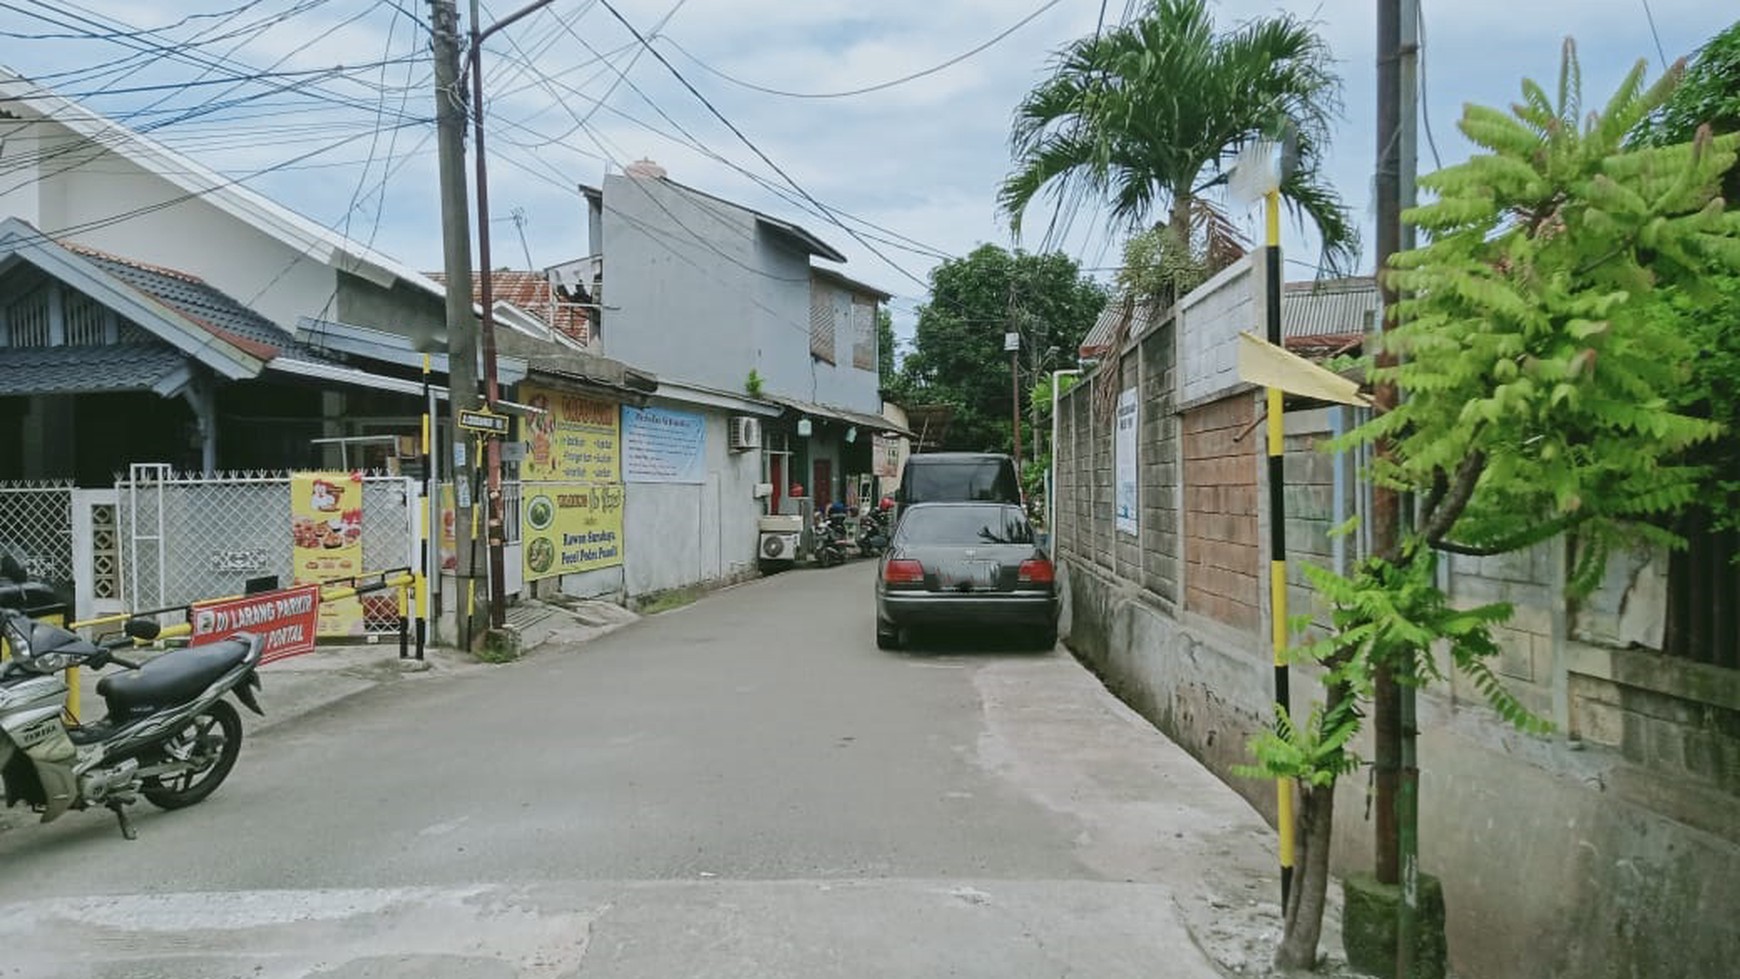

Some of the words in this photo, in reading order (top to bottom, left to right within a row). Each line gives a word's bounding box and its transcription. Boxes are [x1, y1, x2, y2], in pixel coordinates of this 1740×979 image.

[216, 611, 229, 632] DI
[231, 601, 276, 629] LARANG
[276, 594, 312, 620] PARKIR
[267, 624, 305, 649] PORTAL
[23, 724, 57, 741] YAMAHA
